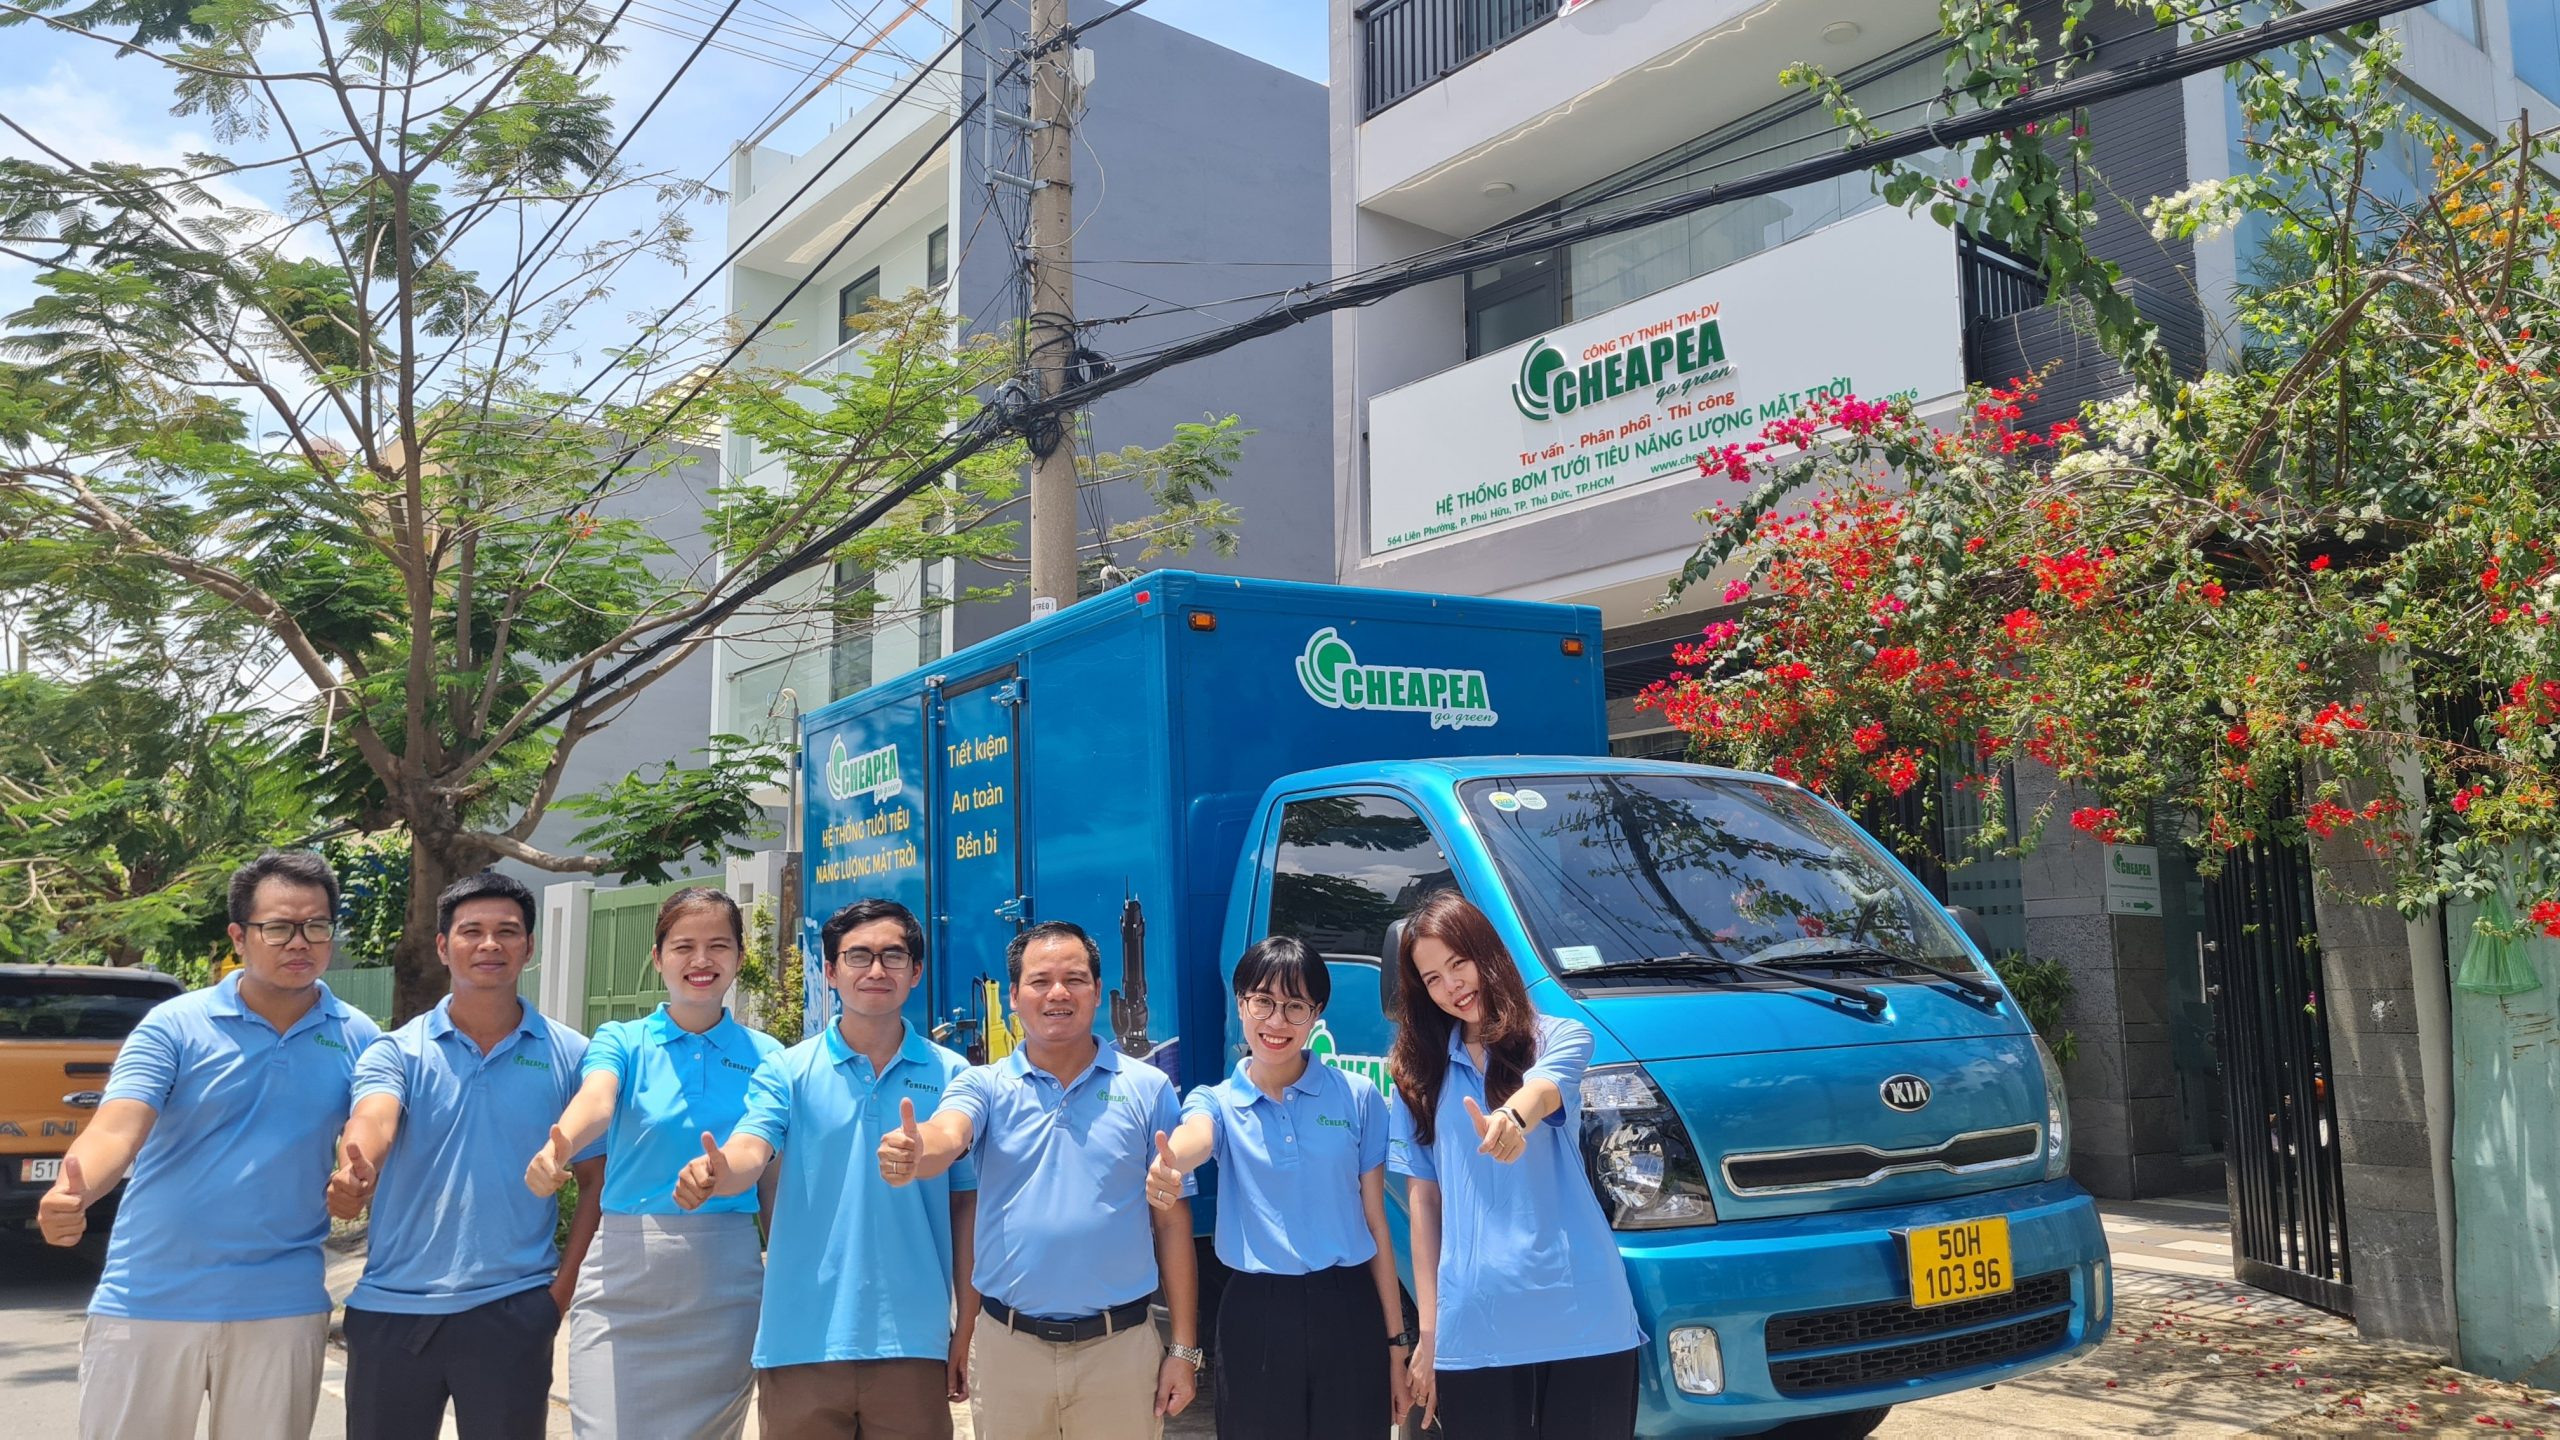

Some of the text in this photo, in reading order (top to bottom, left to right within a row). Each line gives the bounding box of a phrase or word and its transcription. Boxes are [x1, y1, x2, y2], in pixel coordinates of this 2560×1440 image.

[1583, 302, 1720, 361] CÔNG TY TNHH TM-DV
[1553, 319, 1726, 414] CHEAPEA
[1656, 365, 1734, 404] go green
[1436, 377, 1852, 516] HỆ THỐNG BƠM TƯỚI TIÊU NĂNG LƯỢNG MẶT TRỜI
[1519, 451, 1538, 466] Tư
[1541, 442, 1564, 460] vấn
[1580, 429, 1615, 448] Phân
[1620, 414, 1651, 439] phối
[1668, 401, 1692, 421] Thi
[1698, 391, 1735, 412] công
[1387, 534, 1402, 546] 564
[1405, 530, 1421, 542] Liên
[1460, 517, 1468, 527] P.
[1514, 500, 1528, 512] TP.
[1575, 475, 1615, 494] TP.HCM
[1342, 668, 1487, 710] CHEAPEA
[1434, 712, 1494, 726] go green
[842, 748, 898, 796] CHEAPEA
[951, 782, 1004, 815] An toàn
[822, 824, 833, 851] HỆ
[834, 816, 865, 845] THỐNG
[889, 805, 910, 832] TIÊU
[956, 829, 997, 860] Bền bỉ
[894, 840, 917, 869] TRỜI
[1889, 1081, 1928, 1104] KIA
[1938, 1225, 1982, 1261] 50H
[1926, 1258, 2001, 1299] 103.96
